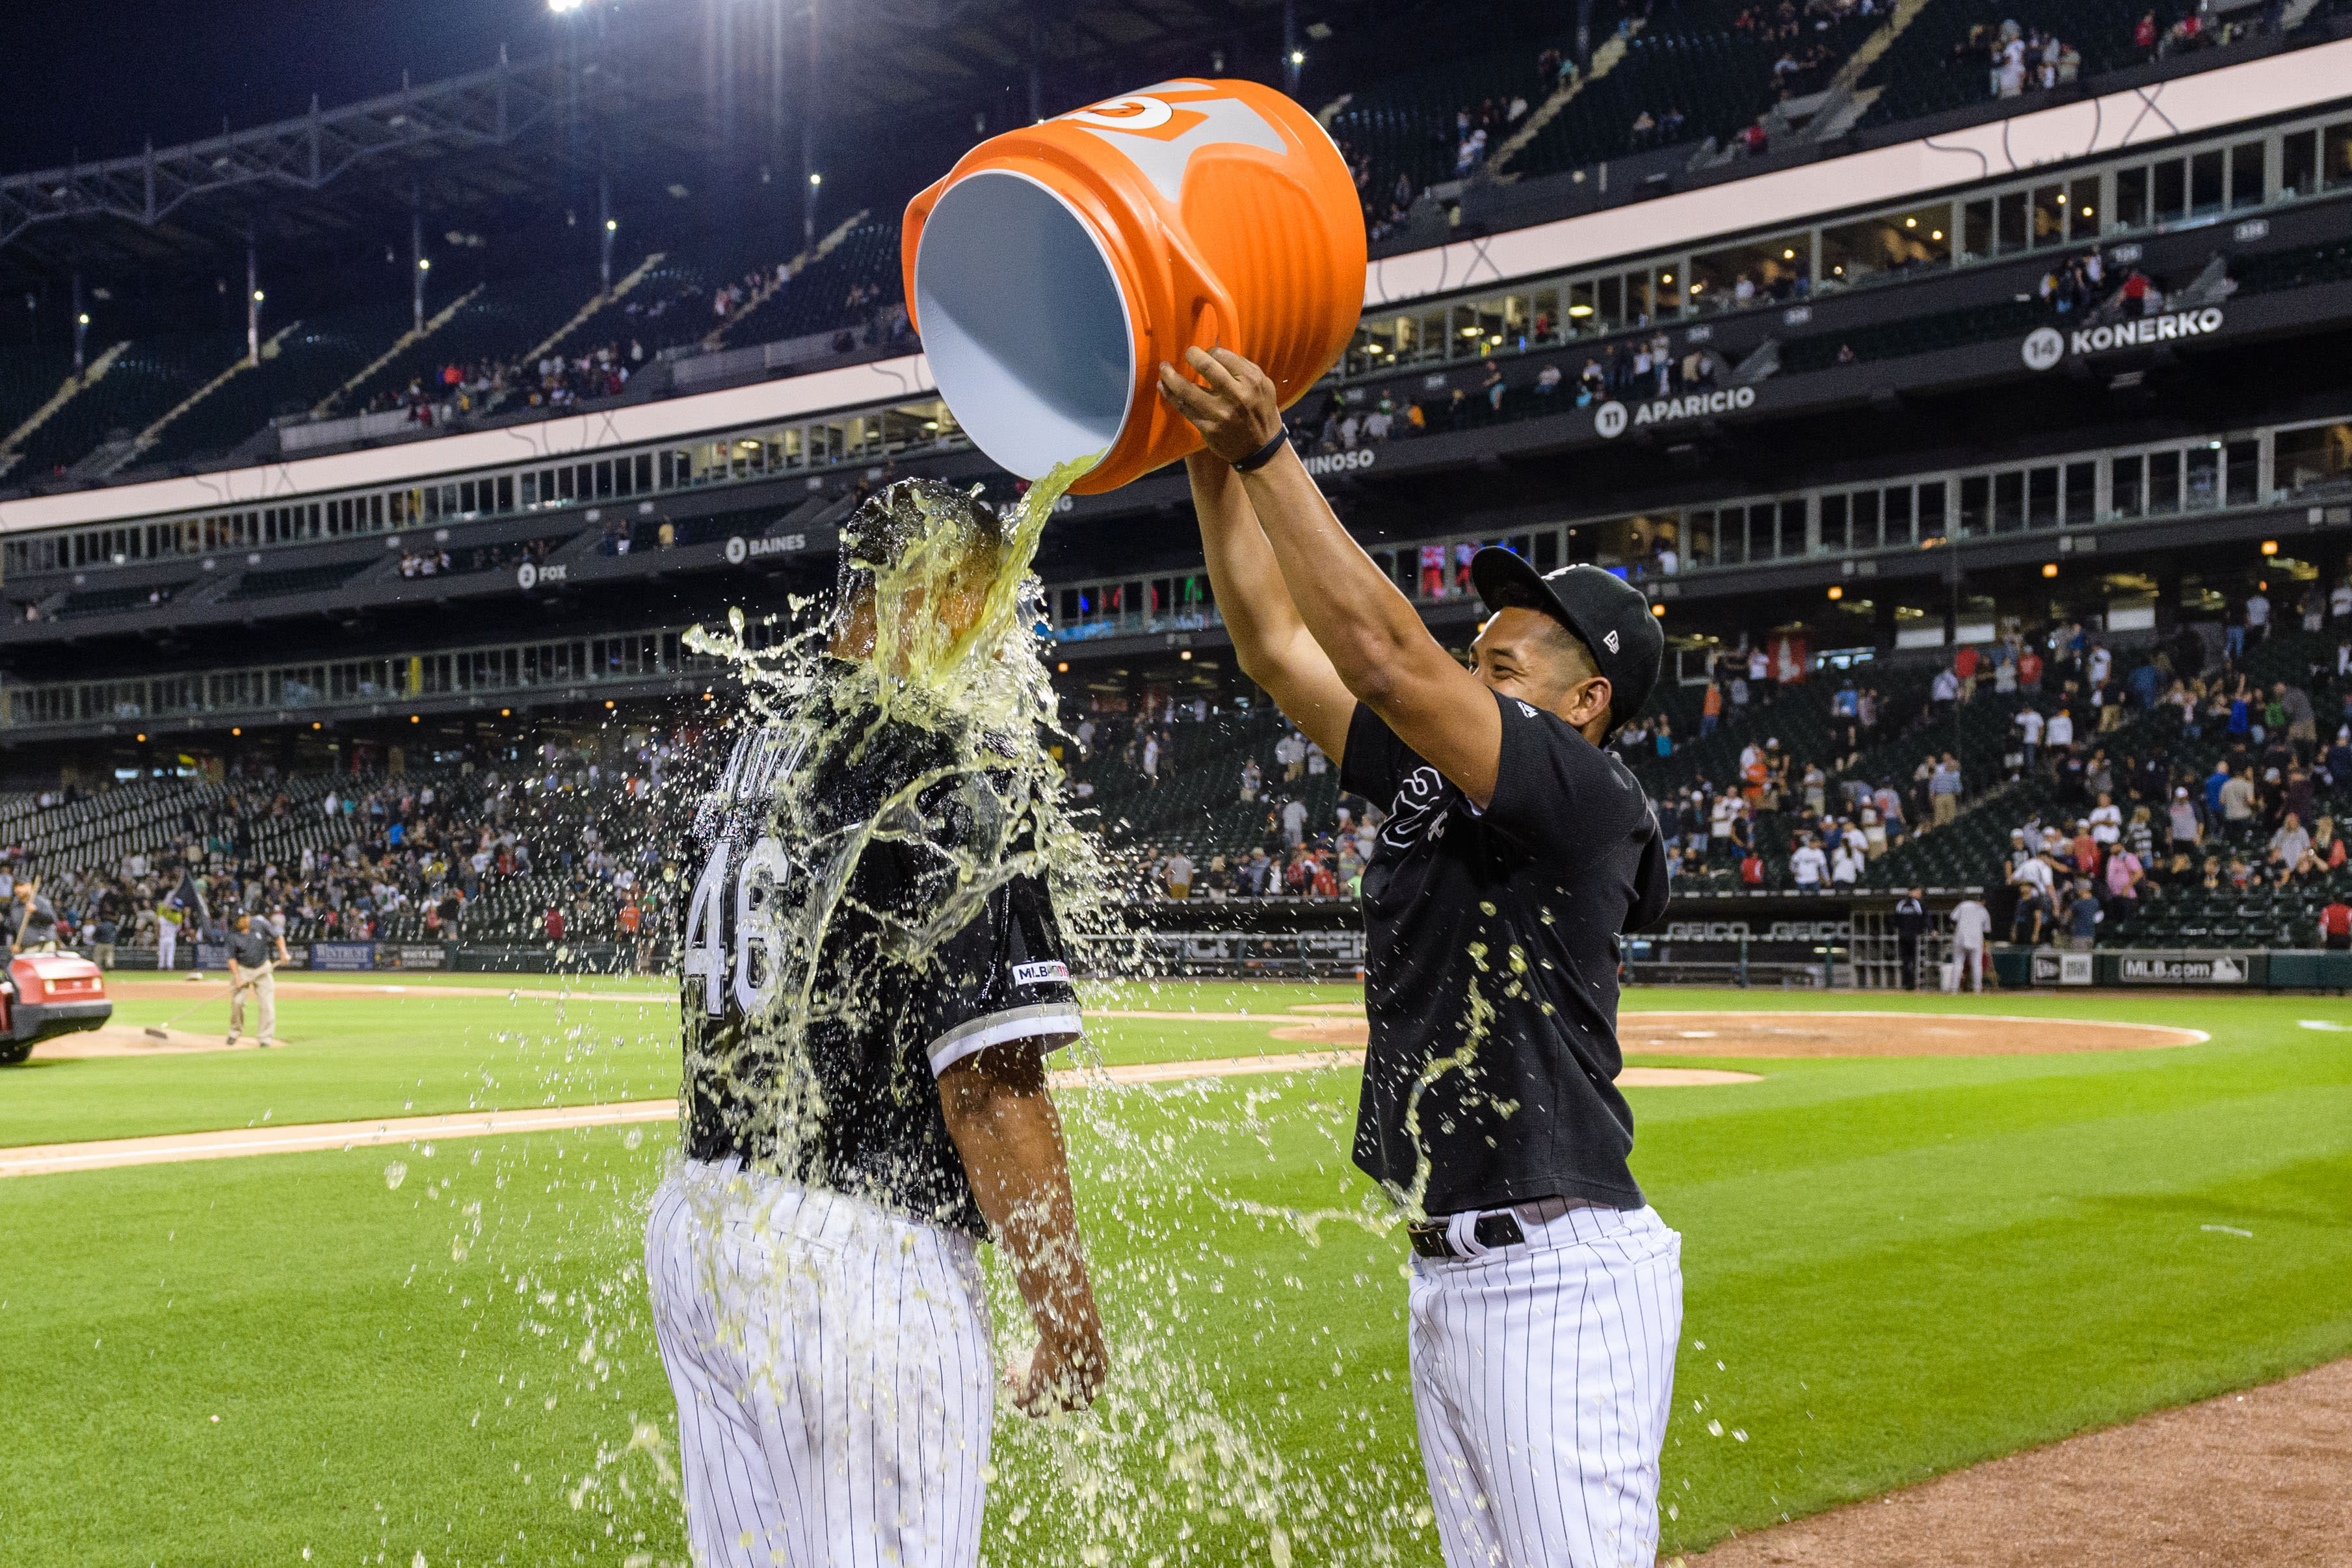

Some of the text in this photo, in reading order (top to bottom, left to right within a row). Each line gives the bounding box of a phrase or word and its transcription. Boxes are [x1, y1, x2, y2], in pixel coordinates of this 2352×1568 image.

[2070, 307, 2223, 355] KONERKO
[1634, 385, 1756, 426] APARICIO
[749, 533, 806, 556] BAINES
[538, 564, 567, 582] FOX
[683, 836, 793, 1021] 46
[2125, 959, 2210, 977] MLB.com
